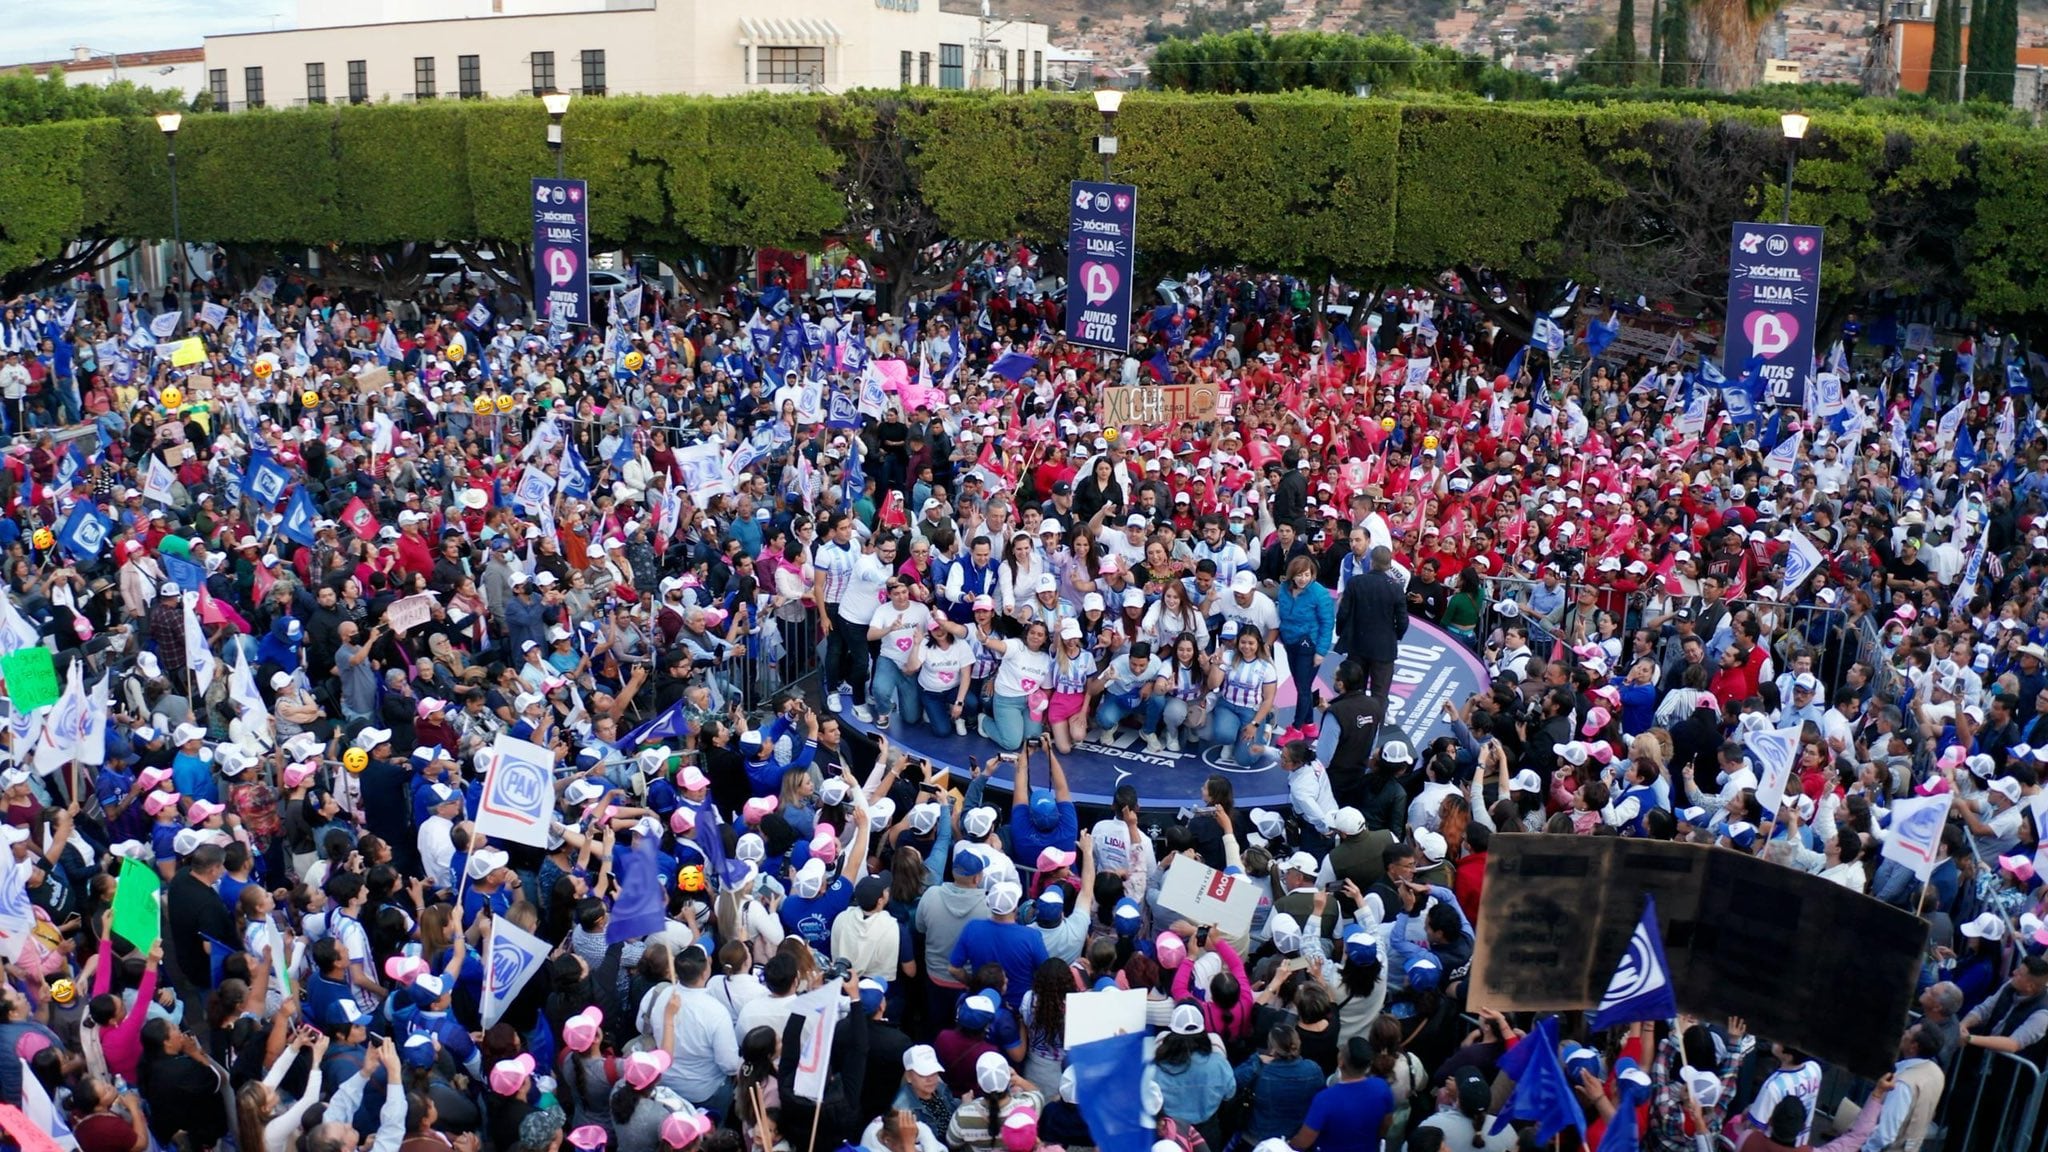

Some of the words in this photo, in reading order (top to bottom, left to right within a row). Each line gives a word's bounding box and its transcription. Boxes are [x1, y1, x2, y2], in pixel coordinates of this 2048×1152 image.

[1083, 220, 1120, 232] XÓCHITL
[1769, 239, 1784, 251] PAN
[1749, 264, 1801, 278] XÓCHITL
[1080, 310, 1117, 325] JUNTAS
[506, 770, 538, 801] PAN
[1215, 874, 1229, 896] OVO
